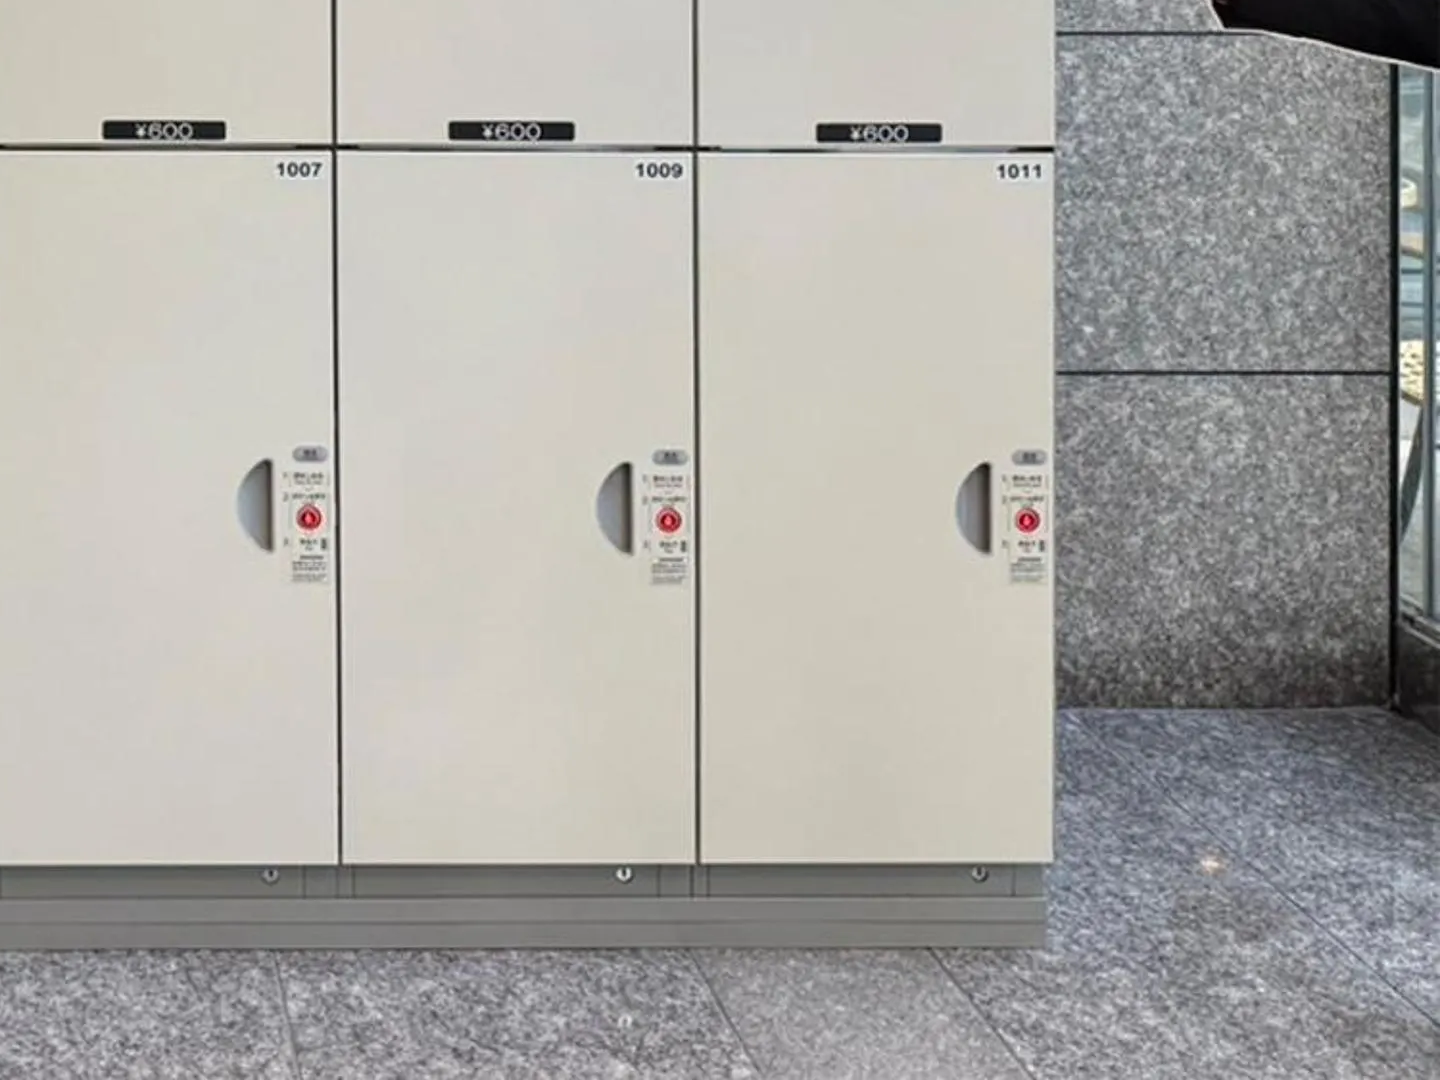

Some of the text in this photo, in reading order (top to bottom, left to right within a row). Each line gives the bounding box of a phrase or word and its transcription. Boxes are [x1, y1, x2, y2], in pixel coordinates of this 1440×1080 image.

[135, 123, 194, 140] ¥600
[482, 123, 542, 140] ¥600
[850, 125, 910, 142] ¥600
[277, 162, 323, 178] 1007
[636, 162, 683, 179] 1009
[997, 163, 1042, 179] 1011
